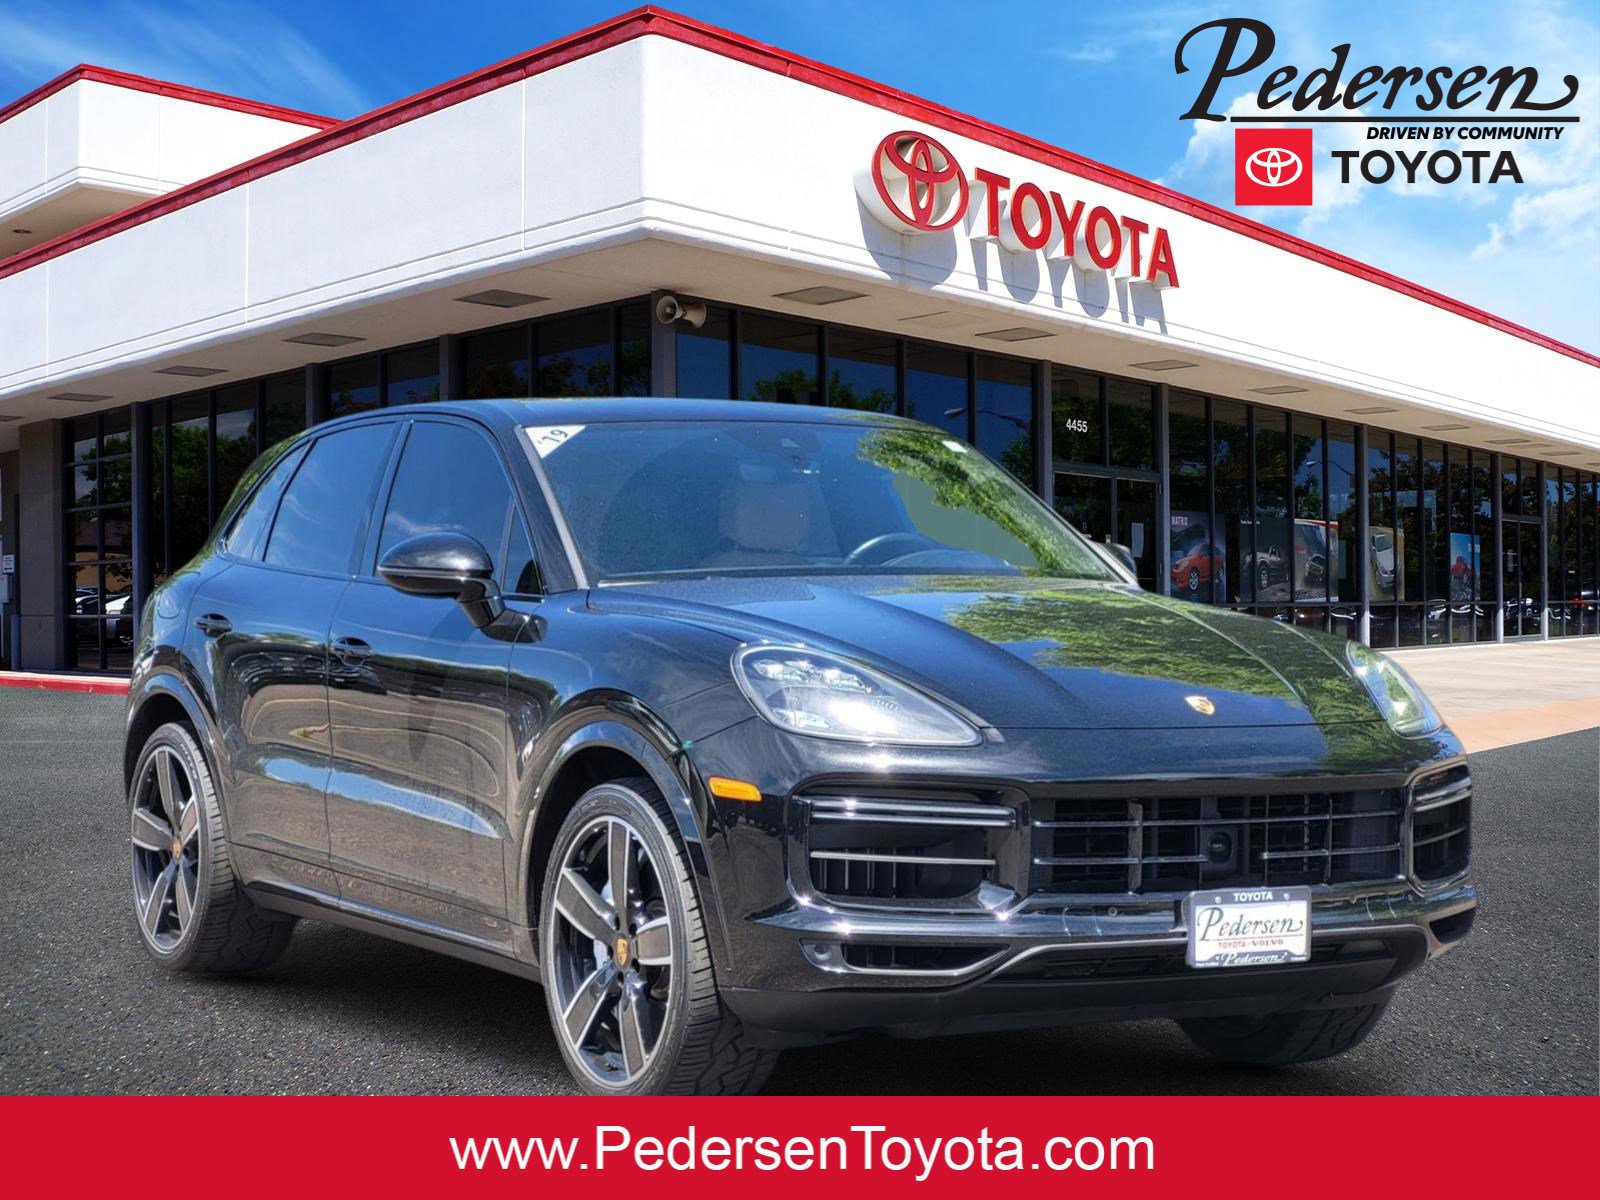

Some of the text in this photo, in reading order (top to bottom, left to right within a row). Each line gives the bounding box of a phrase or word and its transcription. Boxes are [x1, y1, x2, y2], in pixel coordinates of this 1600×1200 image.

[975, 167, 1179, 288] TOYOTA
[1066, 418, 1088, 433] 4455
[1232, 891, 1273, 902] TOYOTA
[1197, 907, 1303, 941] Pedersen
